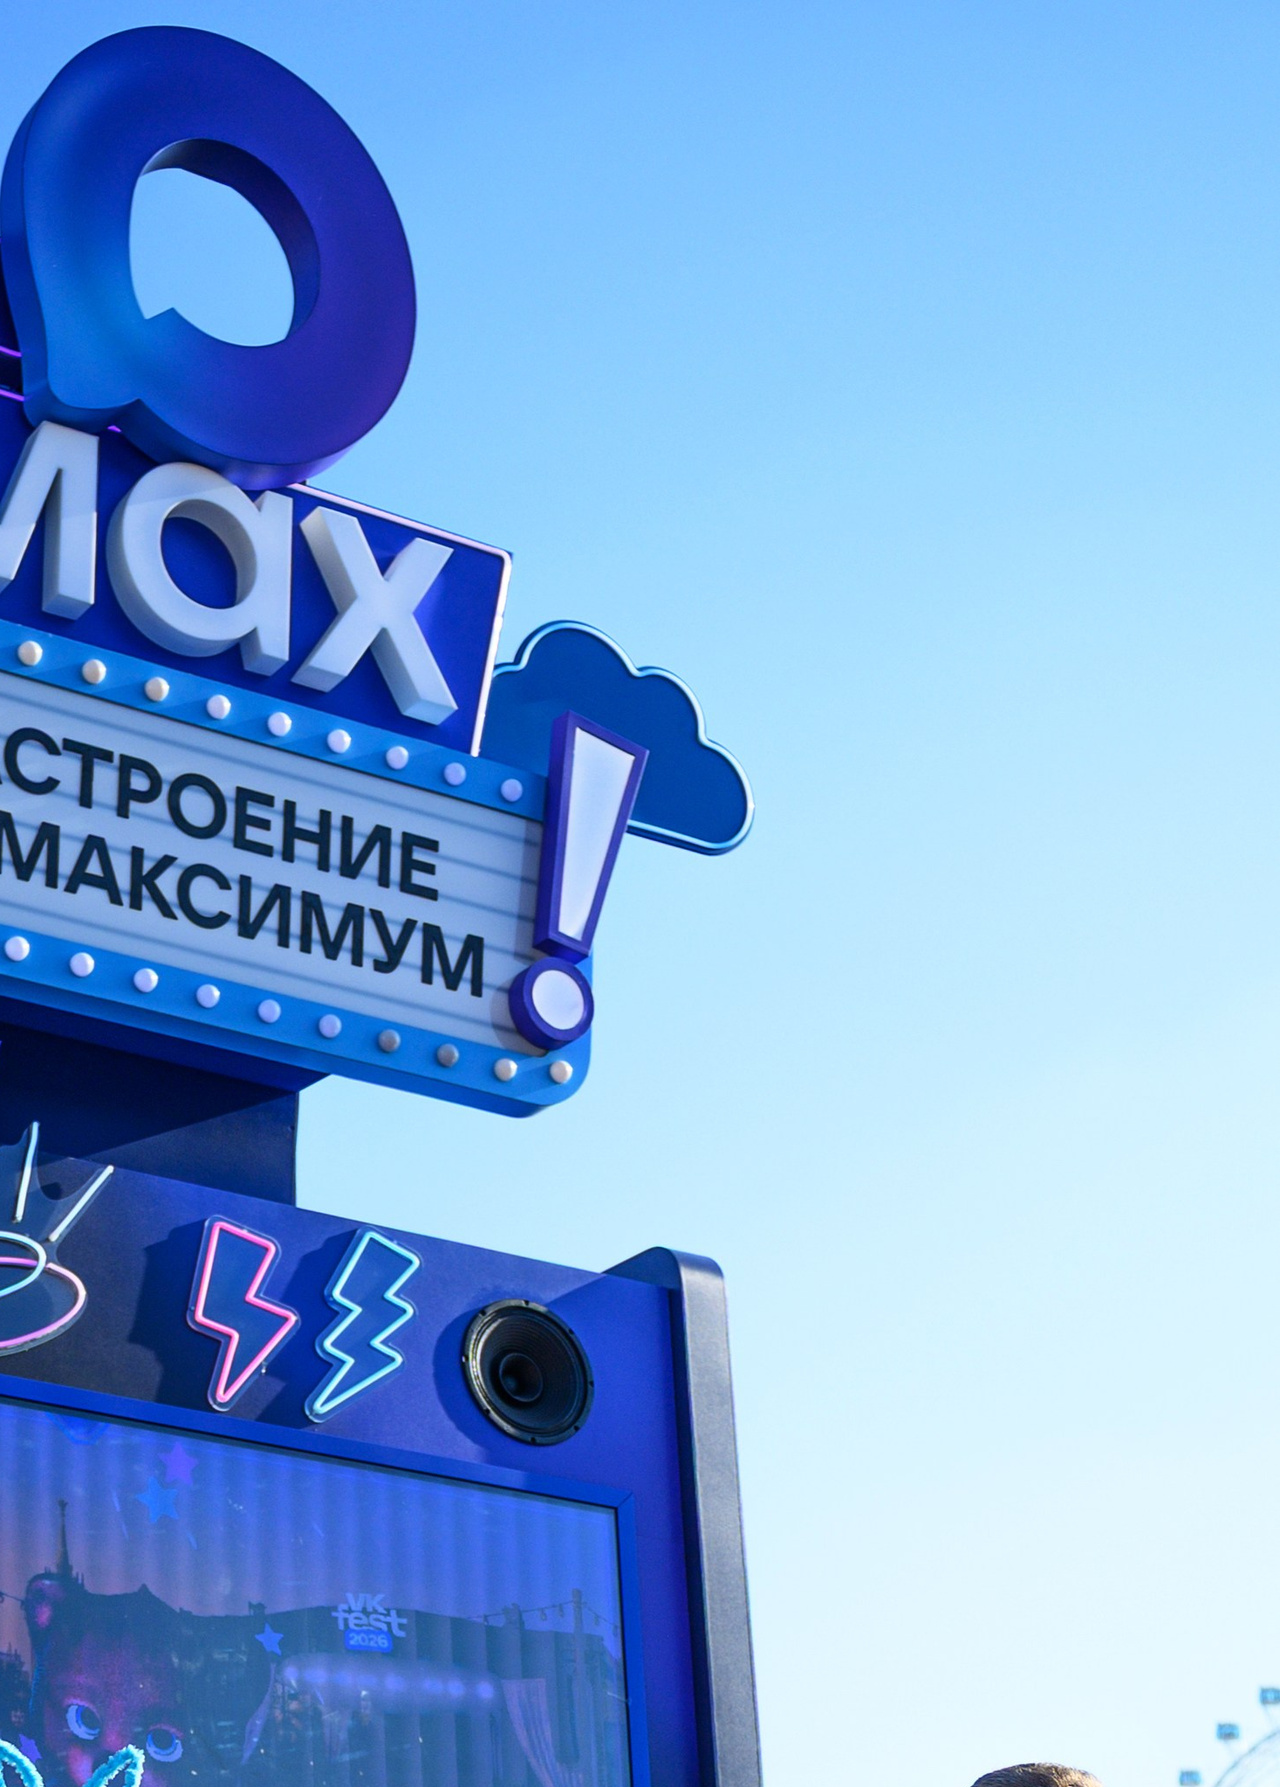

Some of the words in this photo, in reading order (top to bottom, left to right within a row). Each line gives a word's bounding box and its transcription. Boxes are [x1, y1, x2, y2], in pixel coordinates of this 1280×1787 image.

[344, 1592, 388, 1615] VK
[330, 1603, 408, 1638] fest
[348, 1632, 389, 1648] 2026
